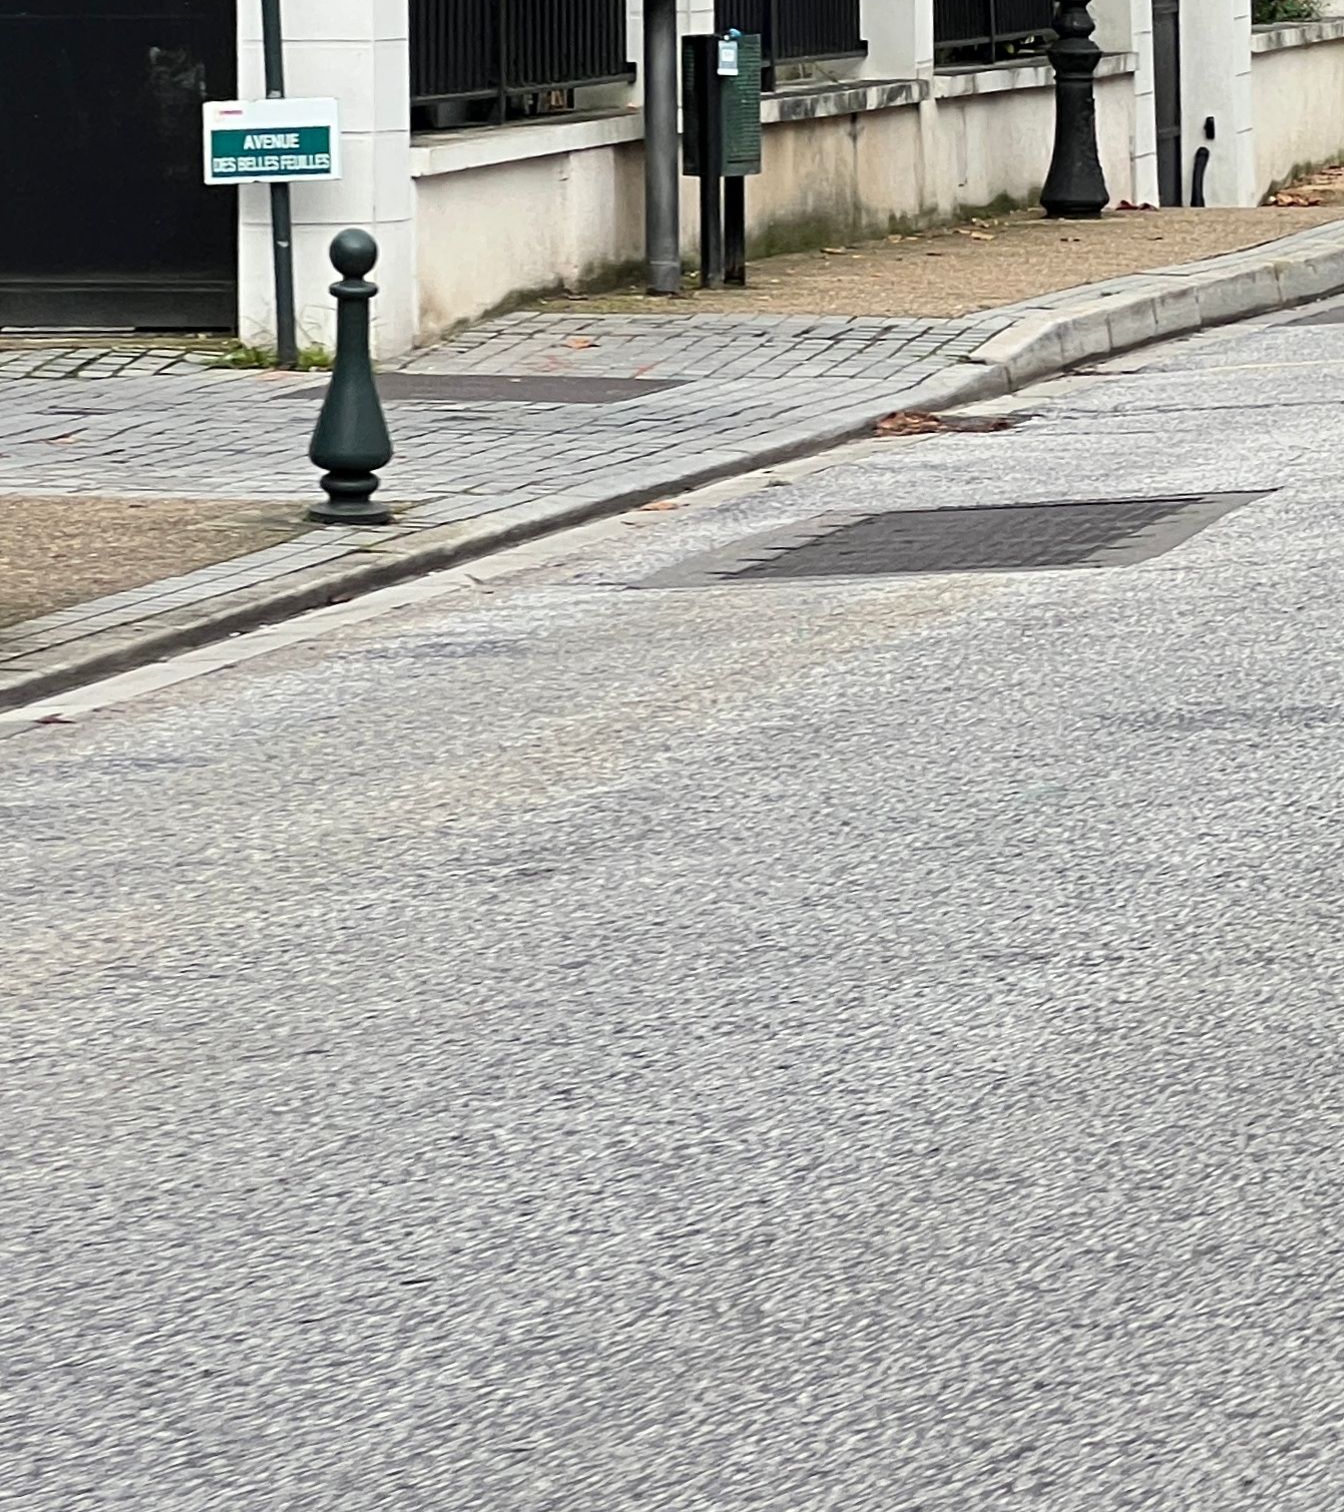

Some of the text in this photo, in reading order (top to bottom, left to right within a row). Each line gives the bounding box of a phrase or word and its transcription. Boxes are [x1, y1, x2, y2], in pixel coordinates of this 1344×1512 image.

[243, 133, 300, 150] AVENUE
[213, 153, 330, 173] DES BELLES FEUILLES
